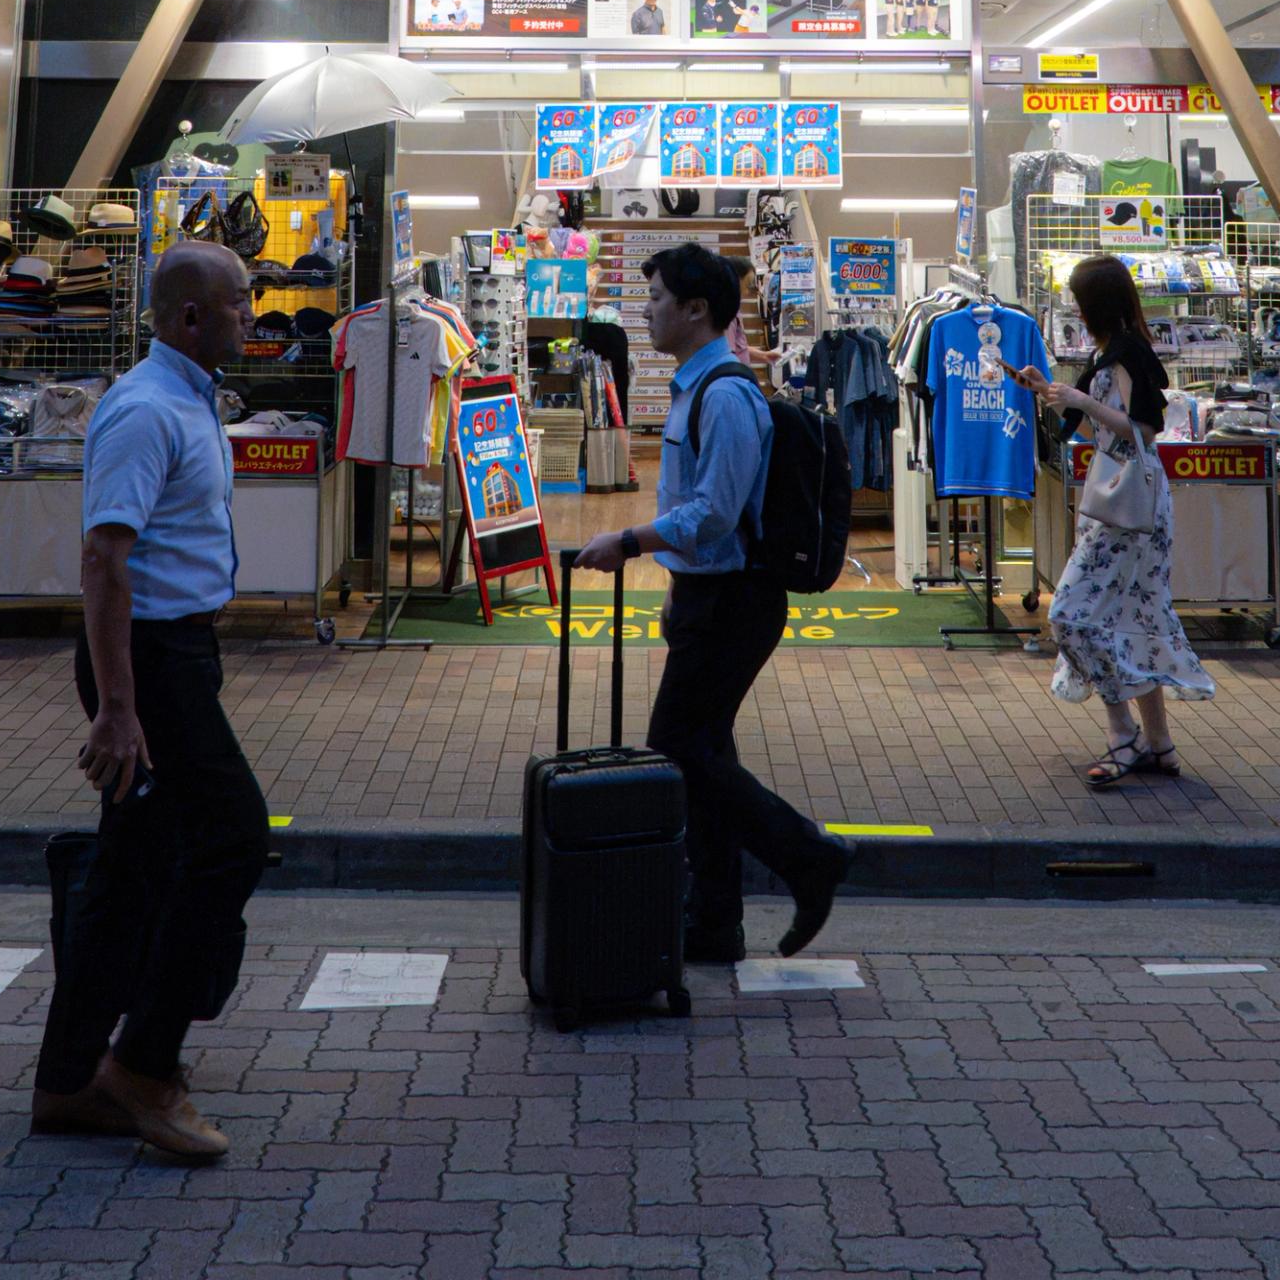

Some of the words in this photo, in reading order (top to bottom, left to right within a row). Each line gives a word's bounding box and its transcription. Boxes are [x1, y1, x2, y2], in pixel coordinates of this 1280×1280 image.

[1027, 95, 1099, 111] OUTLET
[1109, 96, 1183, 113] OUTLET
[552, 110, 575, 127] 60
[613, 110, 636, 127] 60
[674, 108, 696, 126] 60
[735, 109, 758, 126] 60
[796, 109, 819, 126] 60
[963, 388, 1005, 410] BEACH
[473, 409, 497, 437] 60
[246, 443, 310, 459] OUTLET
[1187, 448, 1209, 456] GOLF
[1174, 456, 1258, 477] OUTLET
